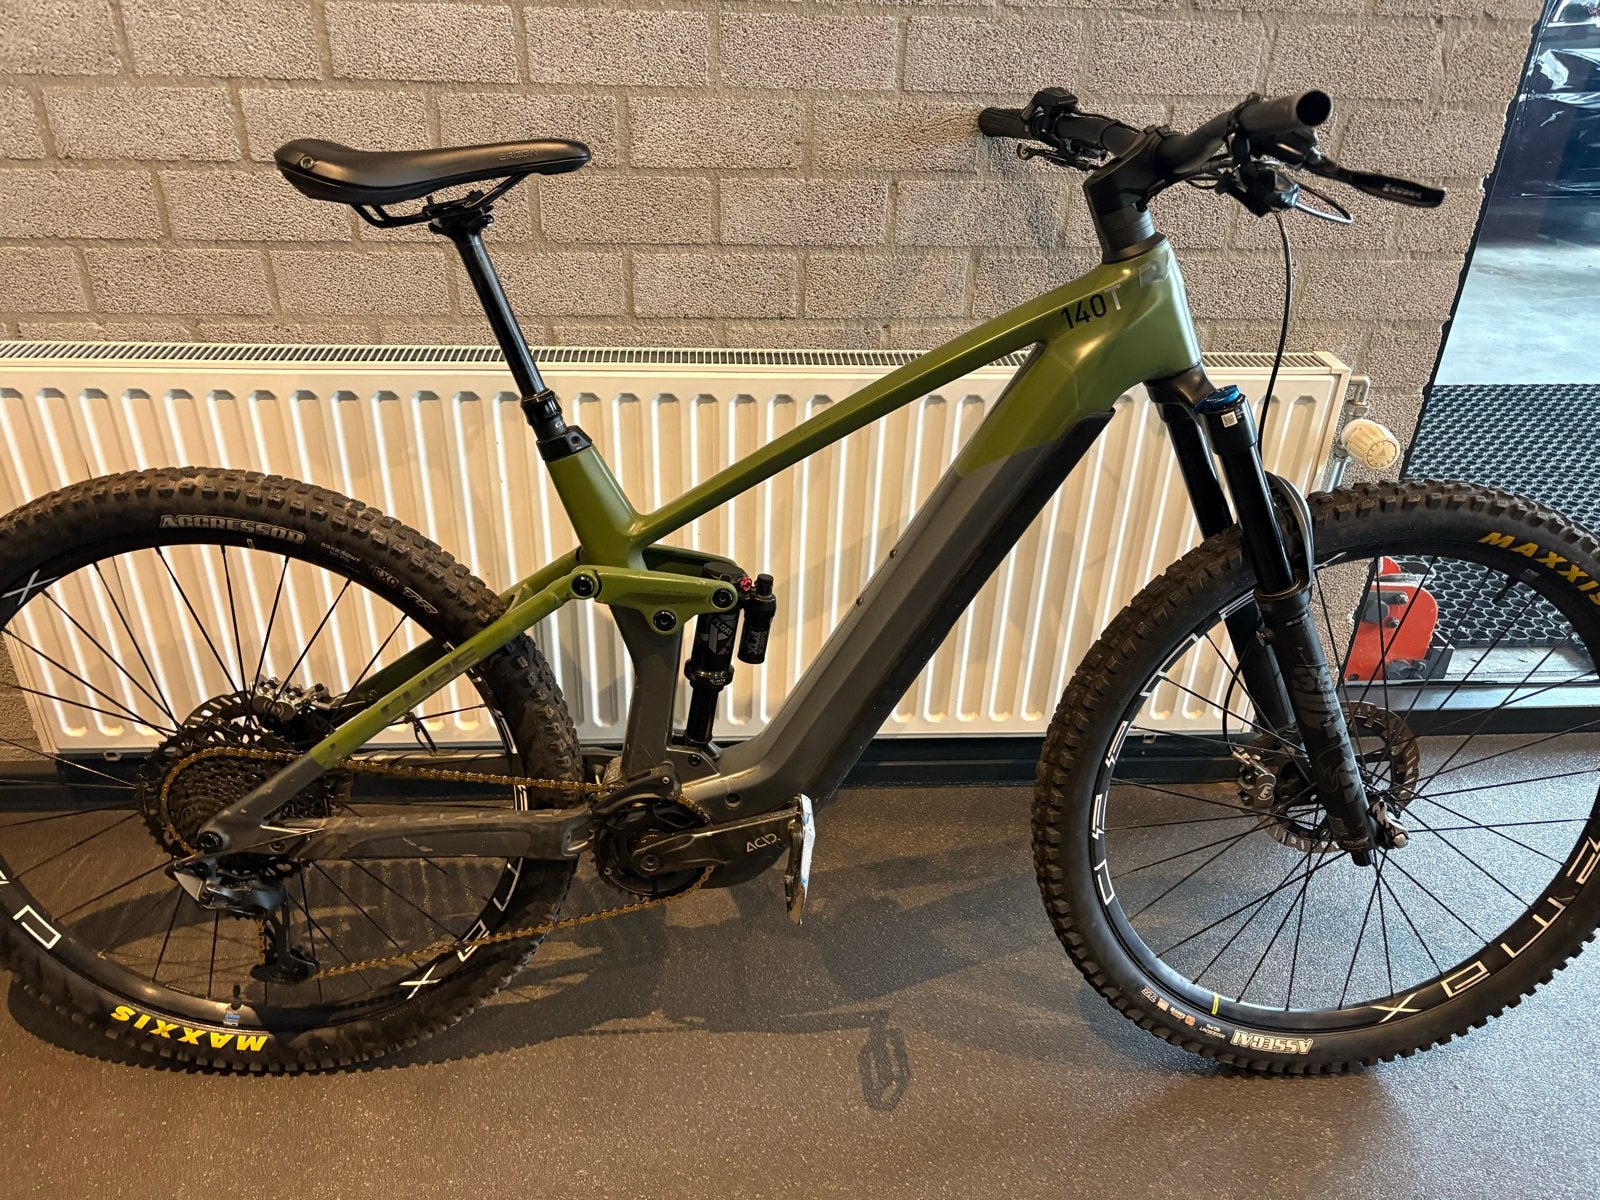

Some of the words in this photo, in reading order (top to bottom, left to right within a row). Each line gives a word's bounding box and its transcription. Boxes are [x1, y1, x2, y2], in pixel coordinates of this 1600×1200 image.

[160, 514, 306, 545] AGGRESSOR
[110, 1005, 268, 1052] MAXXIS
[1230, 1029, 1313, 1055] ASSEGAI
